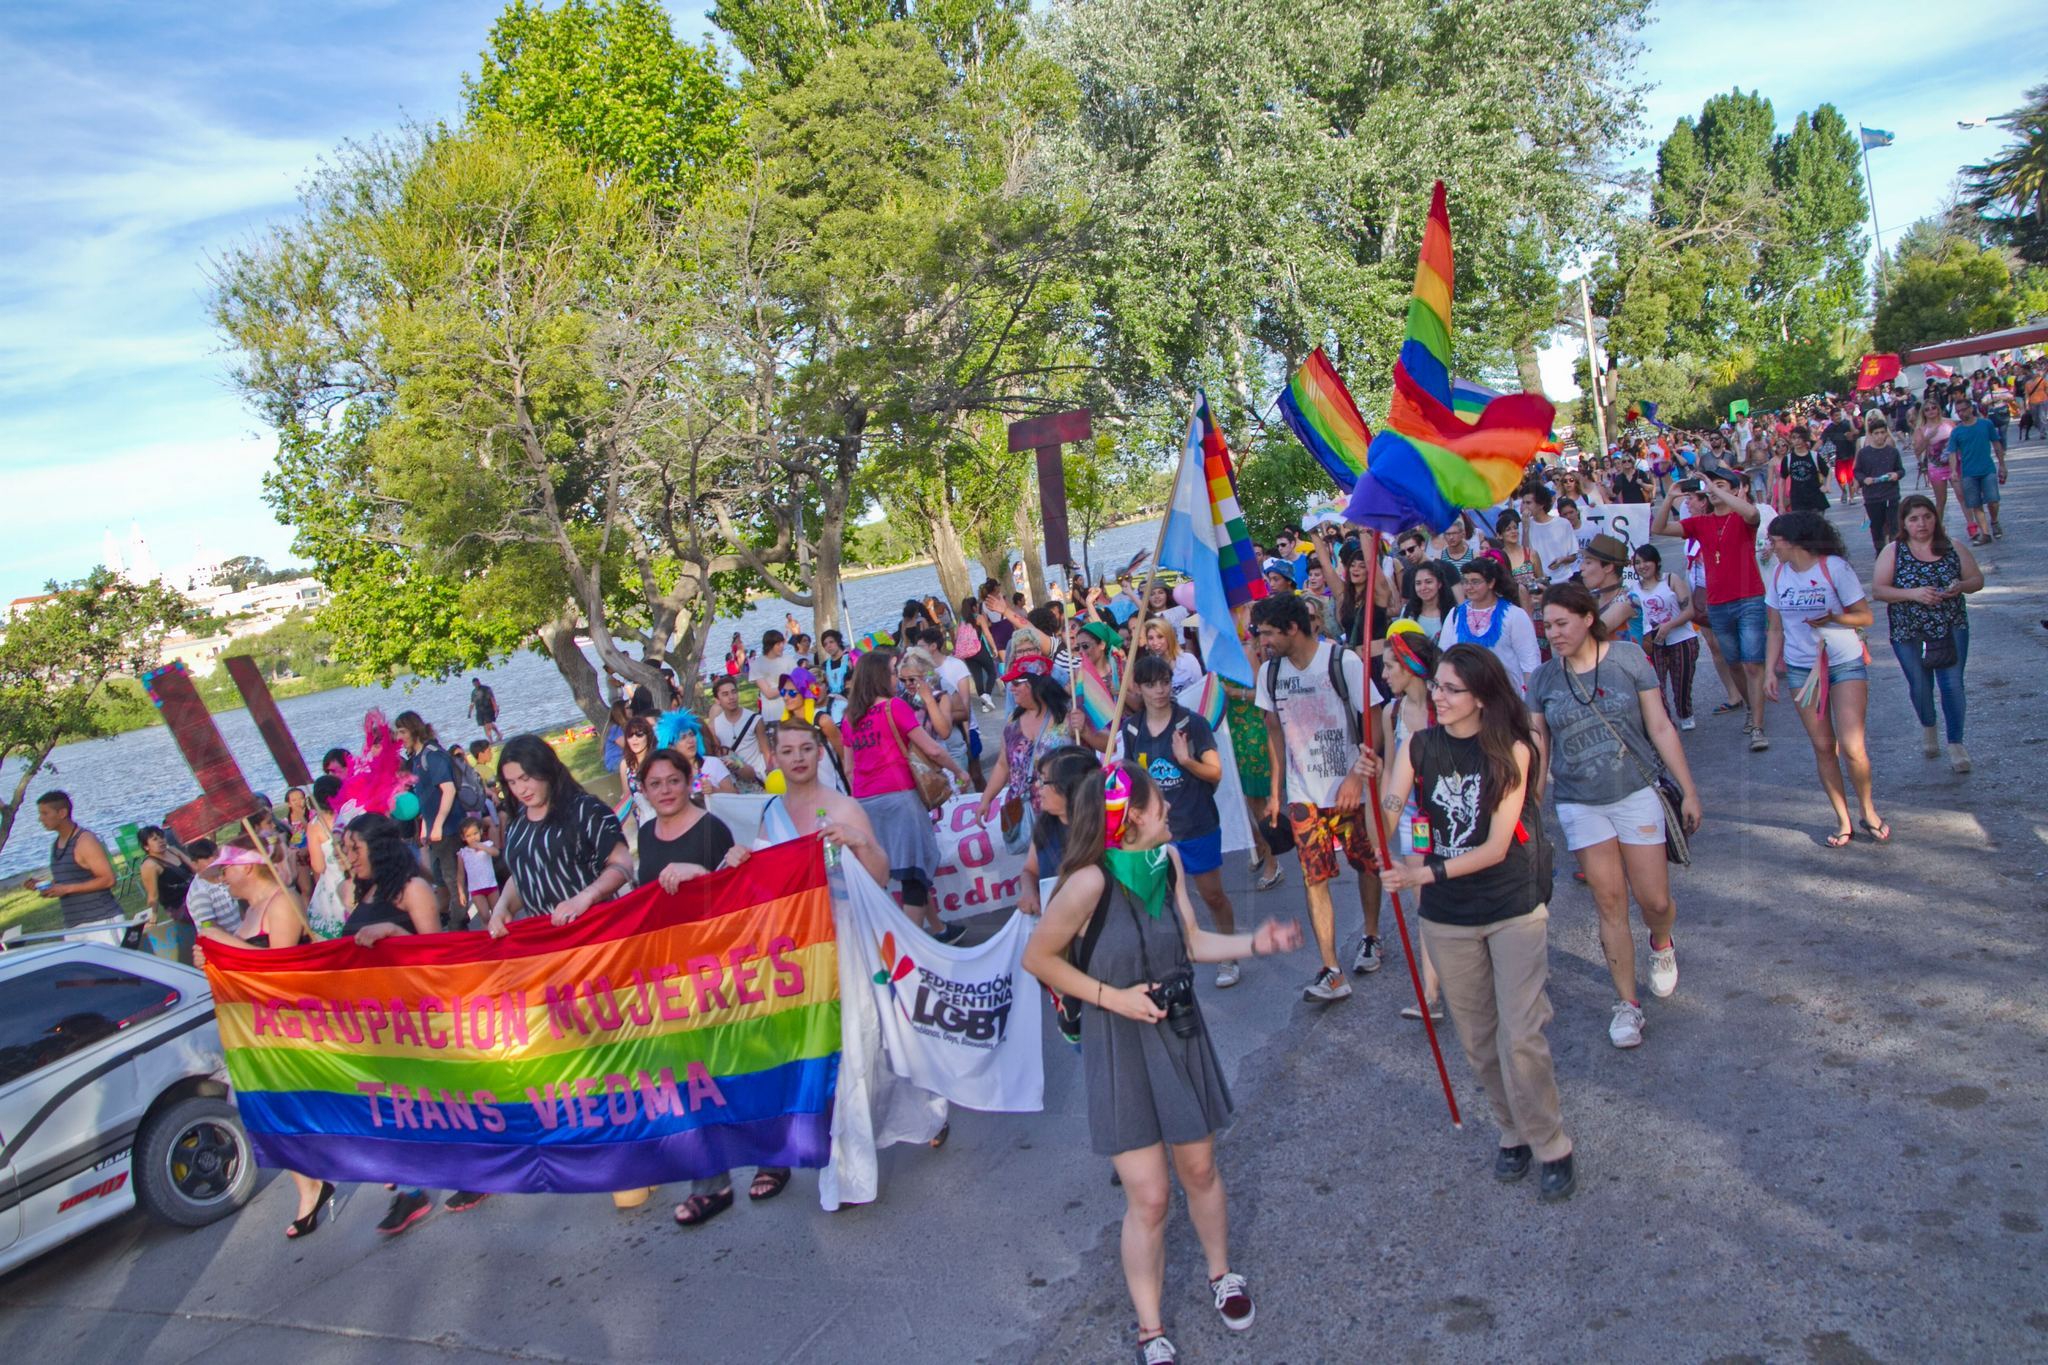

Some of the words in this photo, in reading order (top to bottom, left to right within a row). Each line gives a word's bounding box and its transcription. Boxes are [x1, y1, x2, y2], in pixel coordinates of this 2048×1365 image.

[1564, 725, 1615, 757] STAIR
[892, 874, 1021, 916] iedm
[252, 989, 530, 1050] AGRUPACION
[544, 934, 805, 1040] MUJERES
[917, 966, 1013, 996] FEDERACIÓN
[355, 1081, 507, 1134] TRANS
[524, 1060, 728, 1130] VIEDMA
